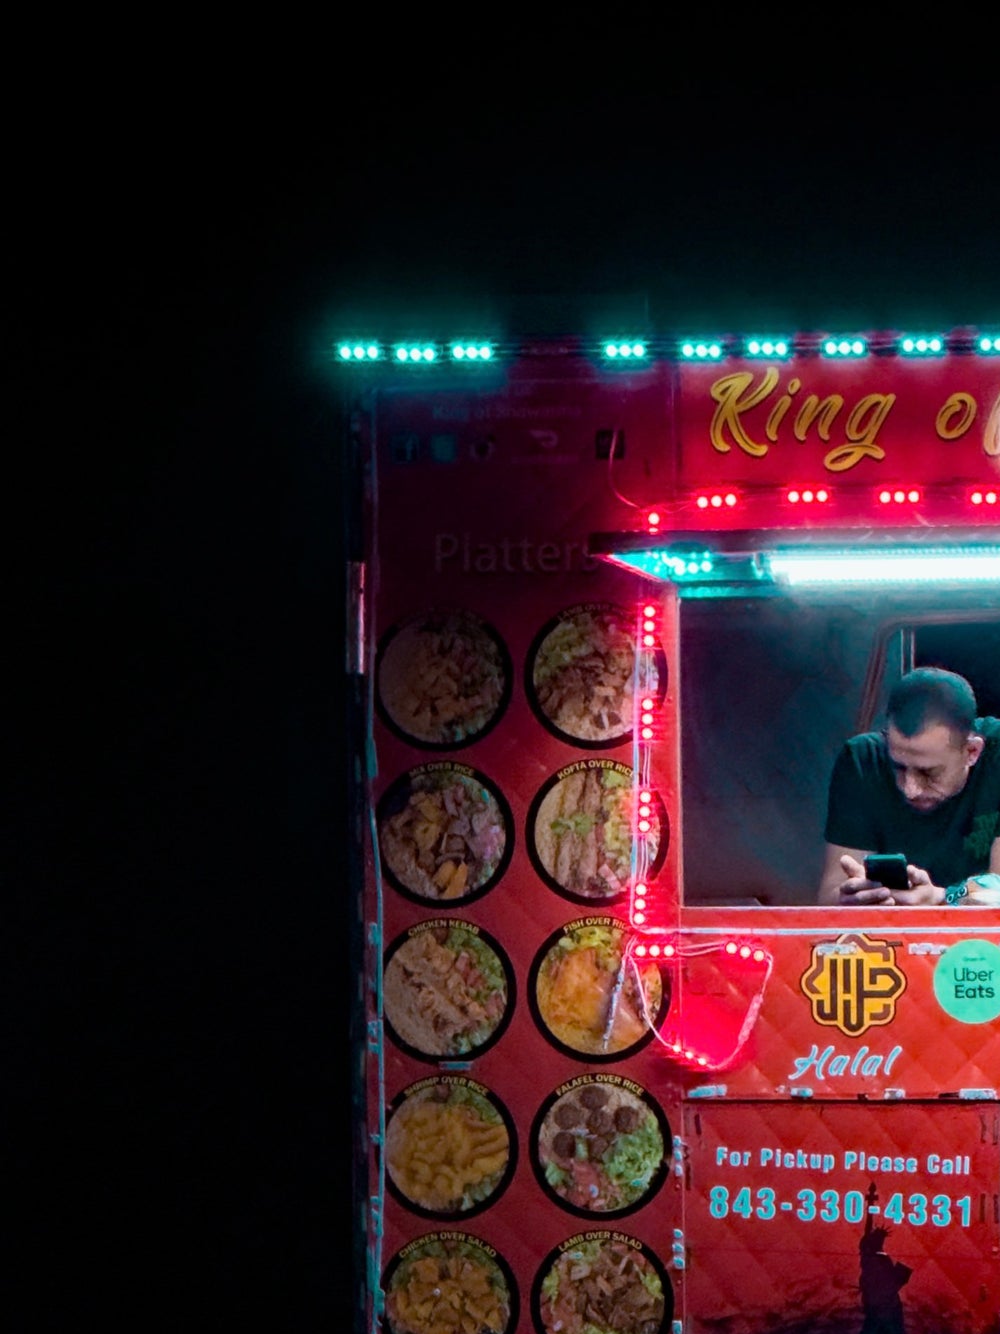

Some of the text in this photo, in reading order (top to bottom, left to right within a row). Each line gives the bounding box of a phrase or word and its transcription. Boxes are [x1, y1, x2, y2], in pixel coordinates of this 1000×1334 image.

[711, 367, 897, 472] King
[434, 532, 600, 573] Platters
[427, 761, 452, 772] OVER
[453, 763, 475, 777] RICE
[557, 760, 587, 779] KOFTA
[587, 758, 614, 769] OVER
[407, 919, 480, 938] CHICKEN KEBAB
[562, 919, 585, 934] FISH
[585, 917, 612, 927] OVER
[953, 967, 994, 982] Uber
[954, 984, 995, 999] Eats
[788, 1044, 903, 1080] Halal
[404, 1075, 490, 1099] SHRIMP OVER RICE
[555, 1073, 645, 1097] FALAFEL OVER RICE
[716, 1146, 970, 1175] For Pickup Please Call
[709, 1185, 972, 1227] 843-330-4331
[399, 1231, 497, 1258] CHICKEN OVER SALAD
[558, 1230, 643, 1250] LAMB OVER SALAD
